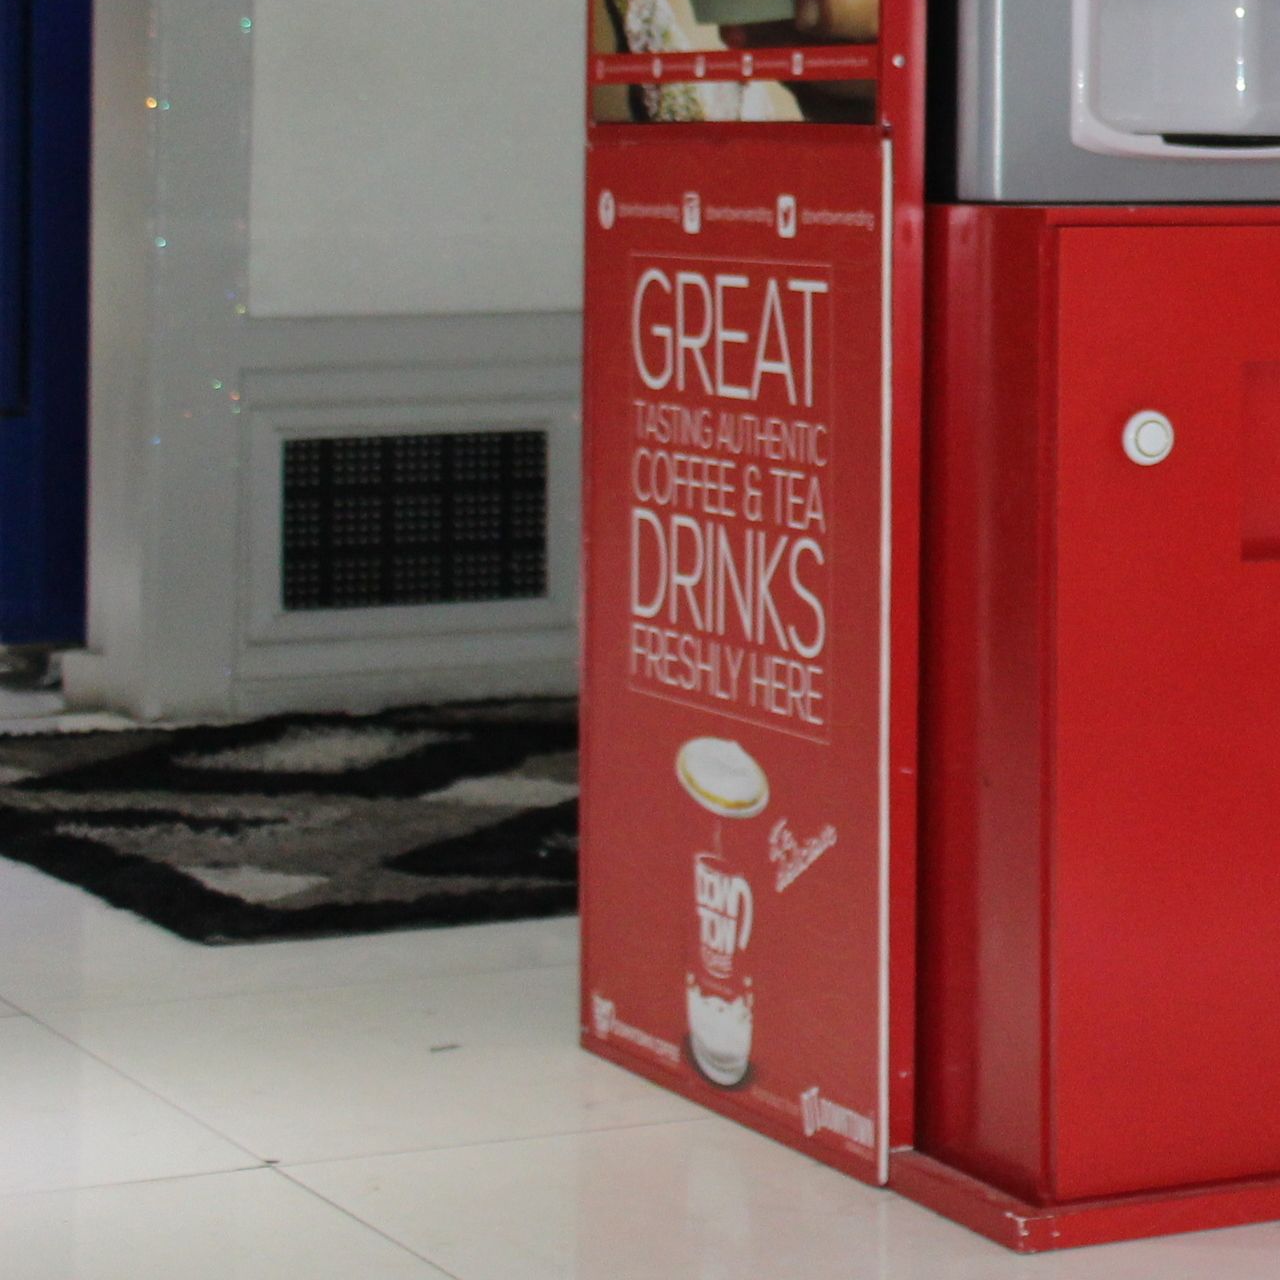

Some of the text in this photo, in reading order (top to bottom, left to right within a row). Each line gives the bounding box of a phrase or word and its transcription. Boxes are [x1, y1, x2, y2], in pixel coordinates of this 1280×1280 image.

[631, 268, 829, 407] GREAT
[633, 399, 827, 467] TASTING AUTHENTIC
[632, 448, 826, 534] COFFEE & TEA
[631, 508, 825, 658] DRINKS
[630, 623, 823, 725] FRESHLY HERE
